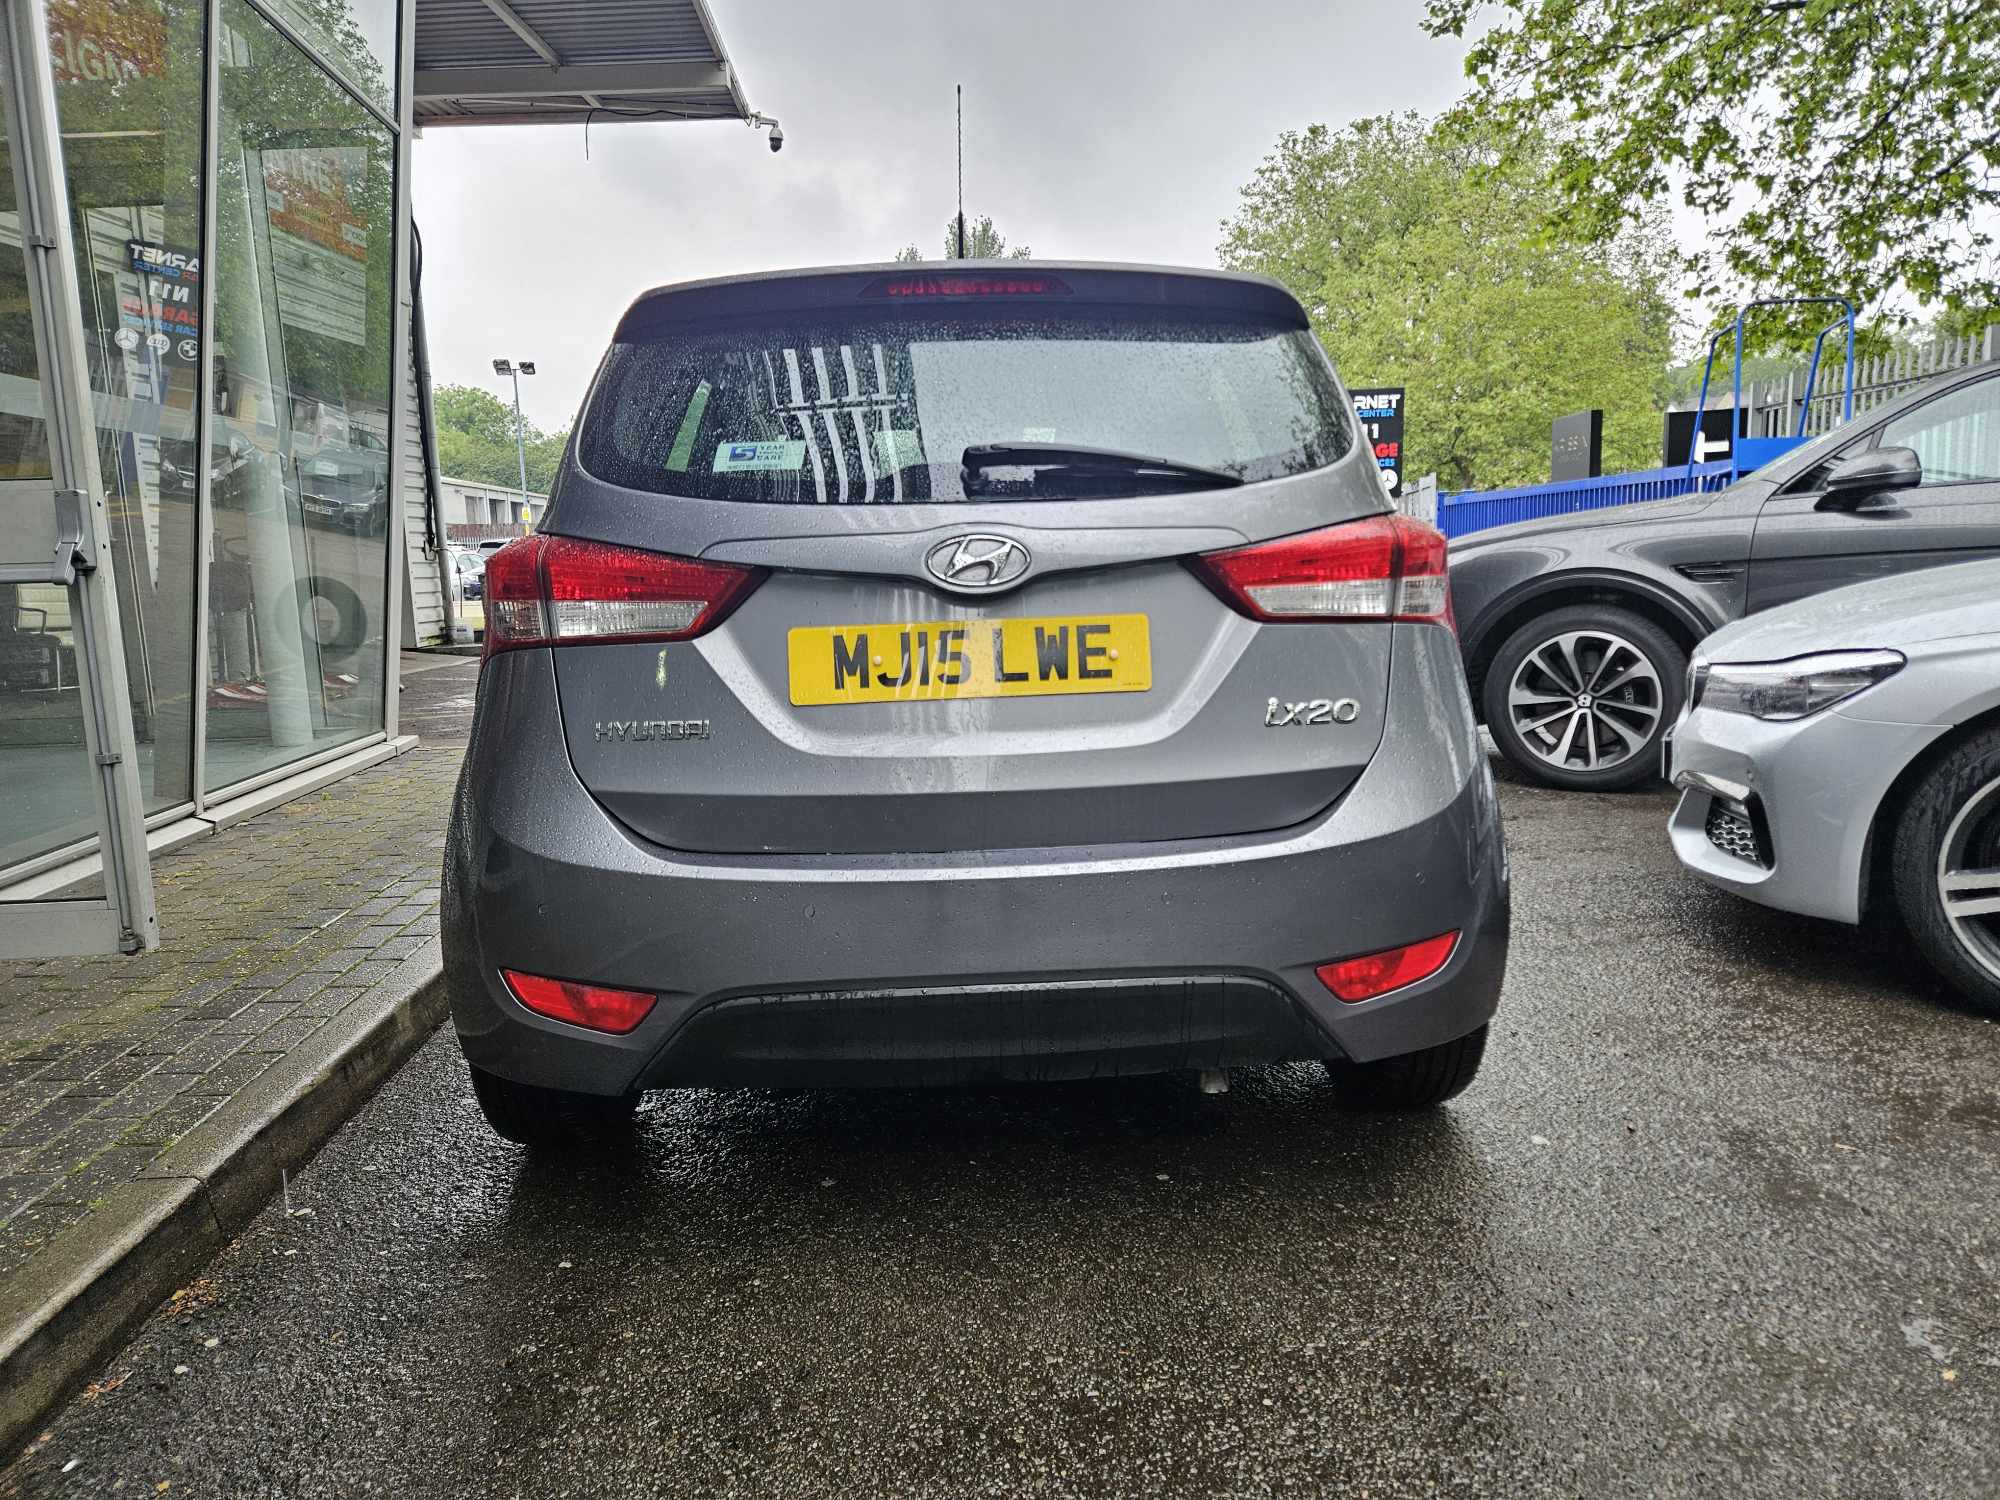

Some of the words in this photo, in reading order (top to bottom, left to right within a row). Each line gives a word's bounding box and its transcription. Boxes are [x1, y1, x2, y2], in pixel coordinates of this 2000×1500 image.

[1353, 394, 1401, 409] RNET
[1357, 408, 1395, 417] CENTER
[833, 629, 971, 690] MJ15
[994, 624, 1113, 683] LWE
[1264, 697, 1361, 727] ix20
[594, 719, 710, 742] HYUNDAI
